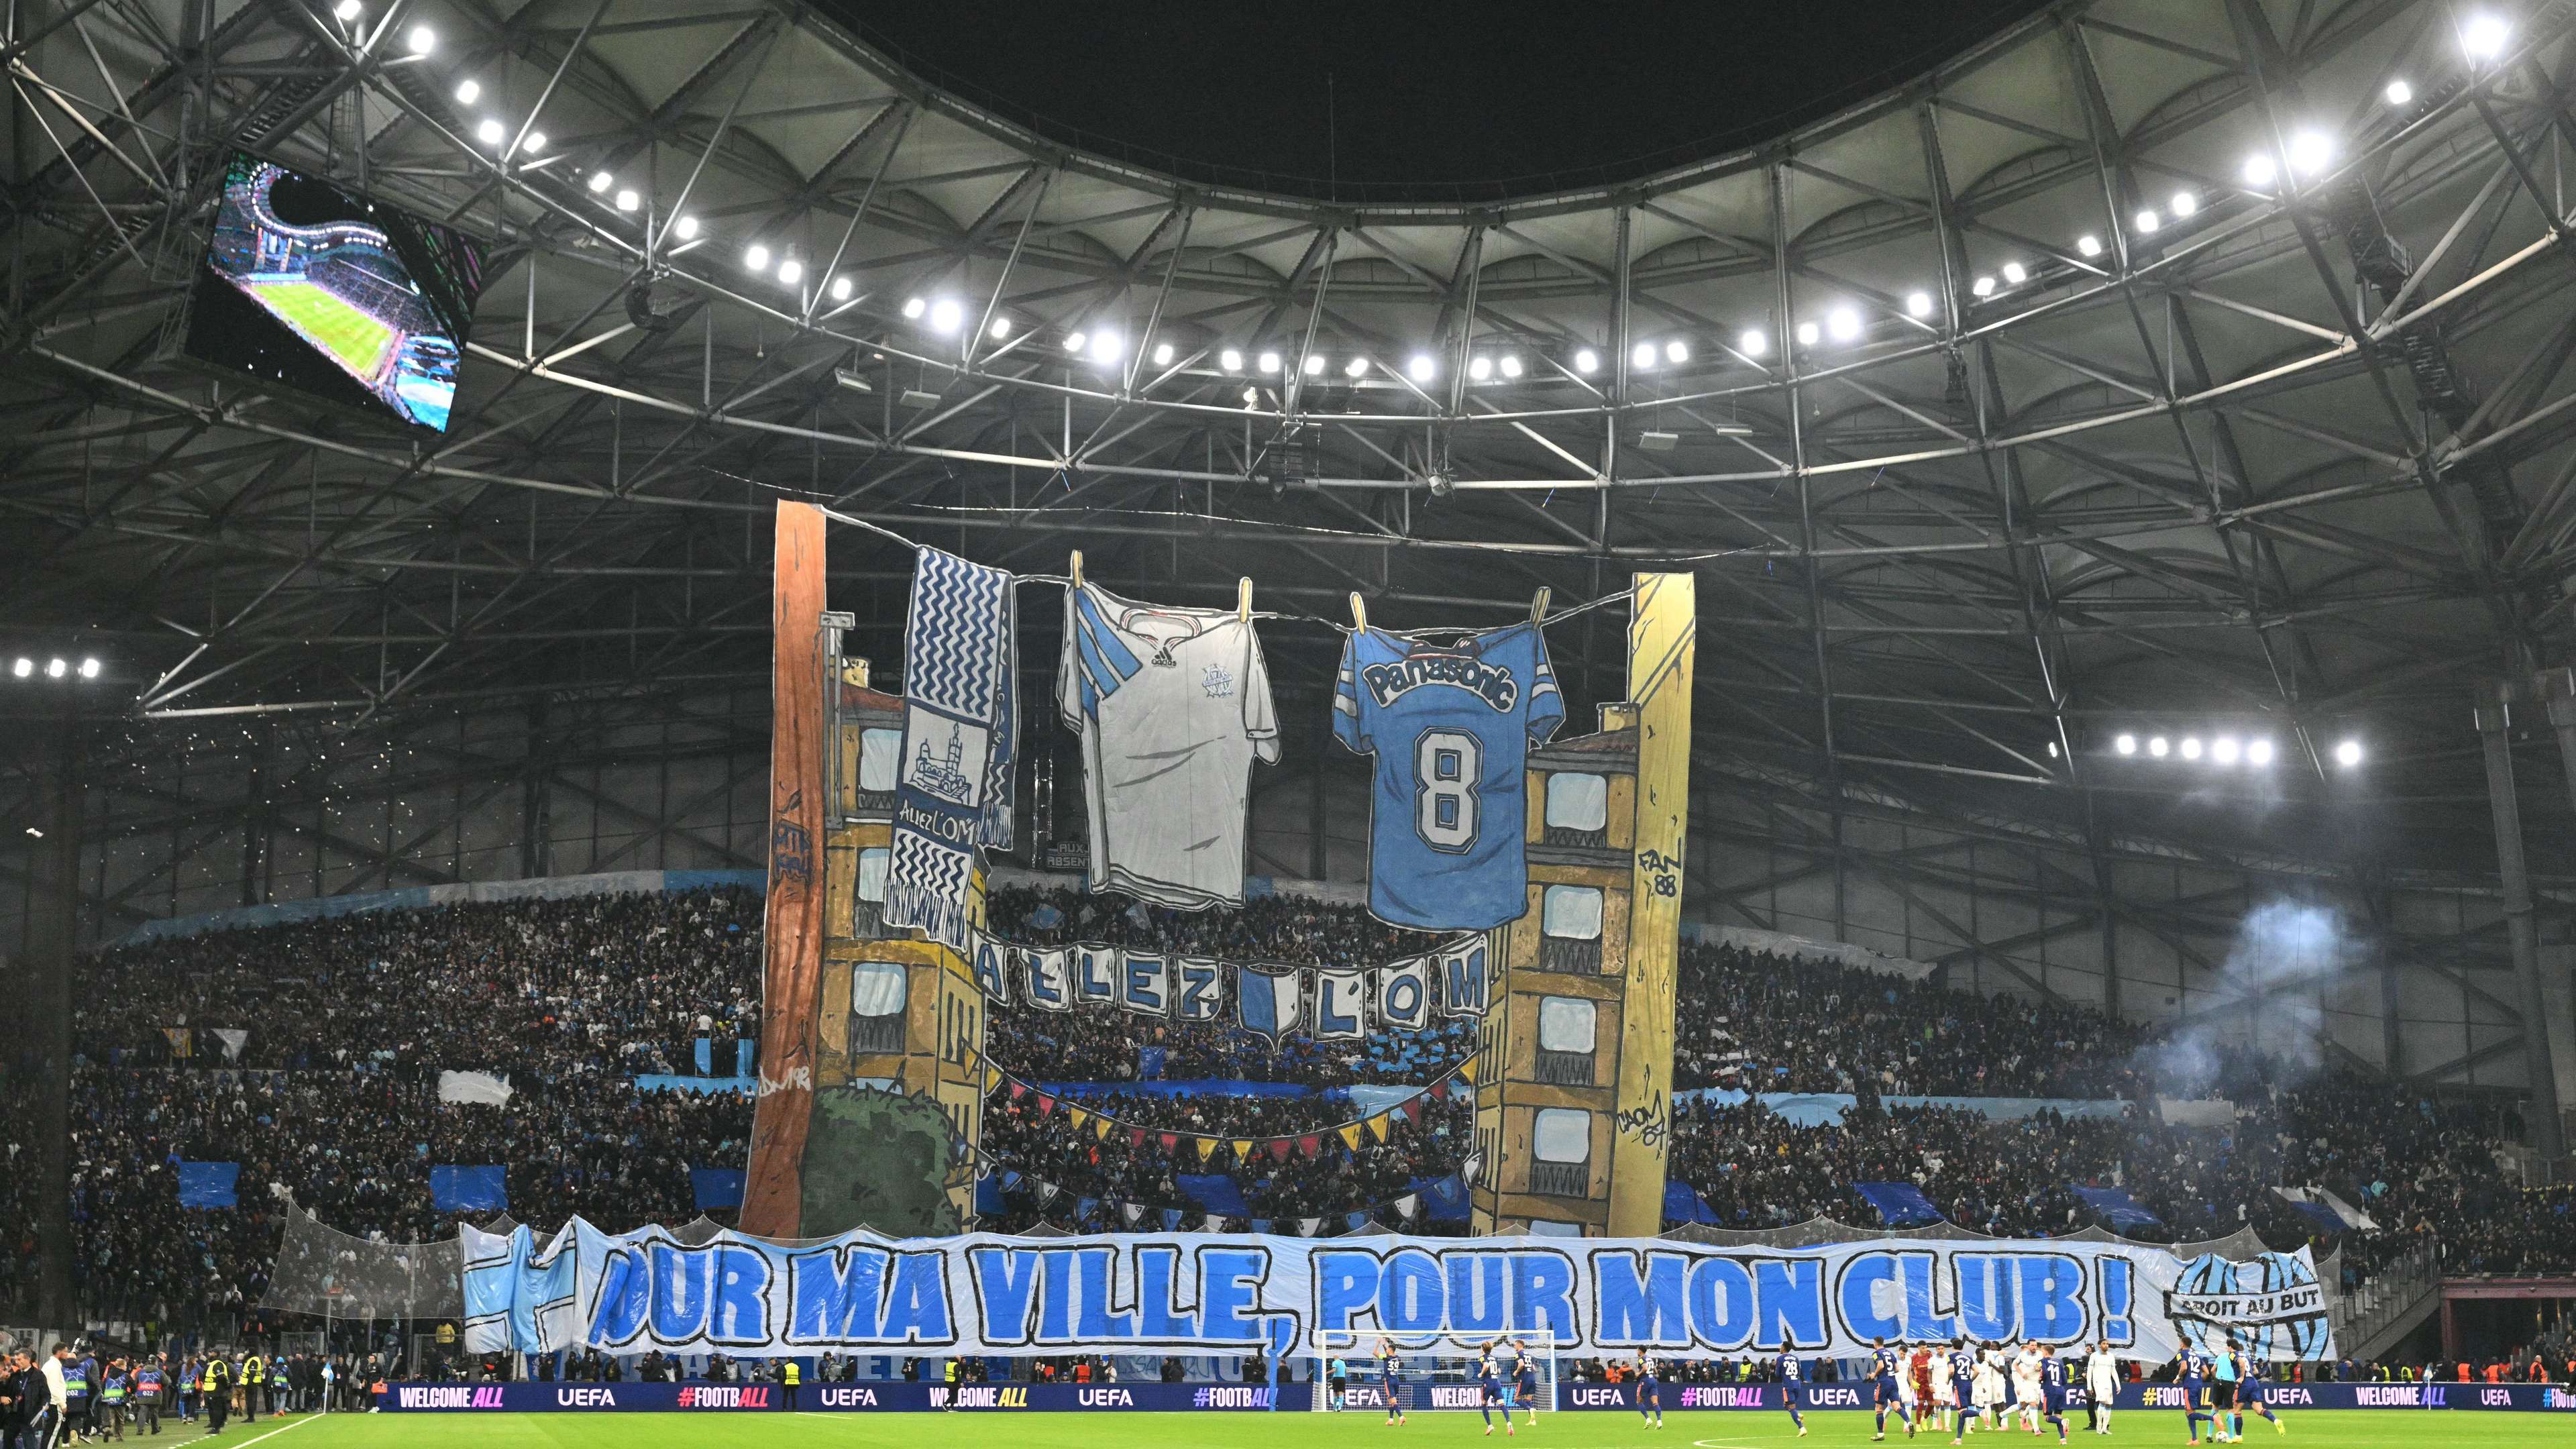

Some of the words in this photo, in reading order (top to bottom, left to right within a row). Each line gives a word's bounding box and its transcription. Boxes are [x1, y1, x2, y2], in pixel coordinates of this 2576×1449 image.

[1364, 659, 1516, 711] Panasonic
[1414, 727, 1483, 856] 8
[1060, 843, 1084, 853] AUX
[1638, 837, 1681, 873] FAN
[1047, 857, 1088, 866] ABSEN
[1654, 875, 1676, 898] 88
[977, 942, 1216, 1014] ALLEZ
[1320, 947, 1486, 1033] L'OM
[784, 1242, 959, 1347] MA
[1309, 1246, 1582, 1351] POUR
[1588, 1248, 1830, 1352] MON
[2281, 1288, 2319, 1311] BUT
[1387, 1360, 1399, 1372] 39
[1489, 1360, 1498, 1375] 10
[1783, 1361, 1799, 1376] 28
[1885, 1356, 1894, 1371] 5
[1956, 1359, 1970, 1375] 21
[2188, 1356, 2200, 1373] 12
[2047, 1364, 2060, 1382] 11
[400, 1387, 471, 1407] WELCOME
[472, 1387, 503, 1407] ALL
[558, 1389, 615, 1406] UEFA
[678, 1387, 768, 1407] #FOOTBALL
[822, 1389, 877, 1406] UEFA
[998, 1387, 1028, 1407] ALL
[1079, 1389, 1133, 1406] UEFA
[1572, 1389, 1625, 1406] UEFA
[1681, 1387, 1763, 1407] #FOOTBALL
[1810, 1389, 1860, 1405] UEFA
[2264, 1388, 2313, 1405] UEFA
[2356, 1387, 2420, 1405] WELCOME
[2481, 1389, 2512, 1405] UEFA
